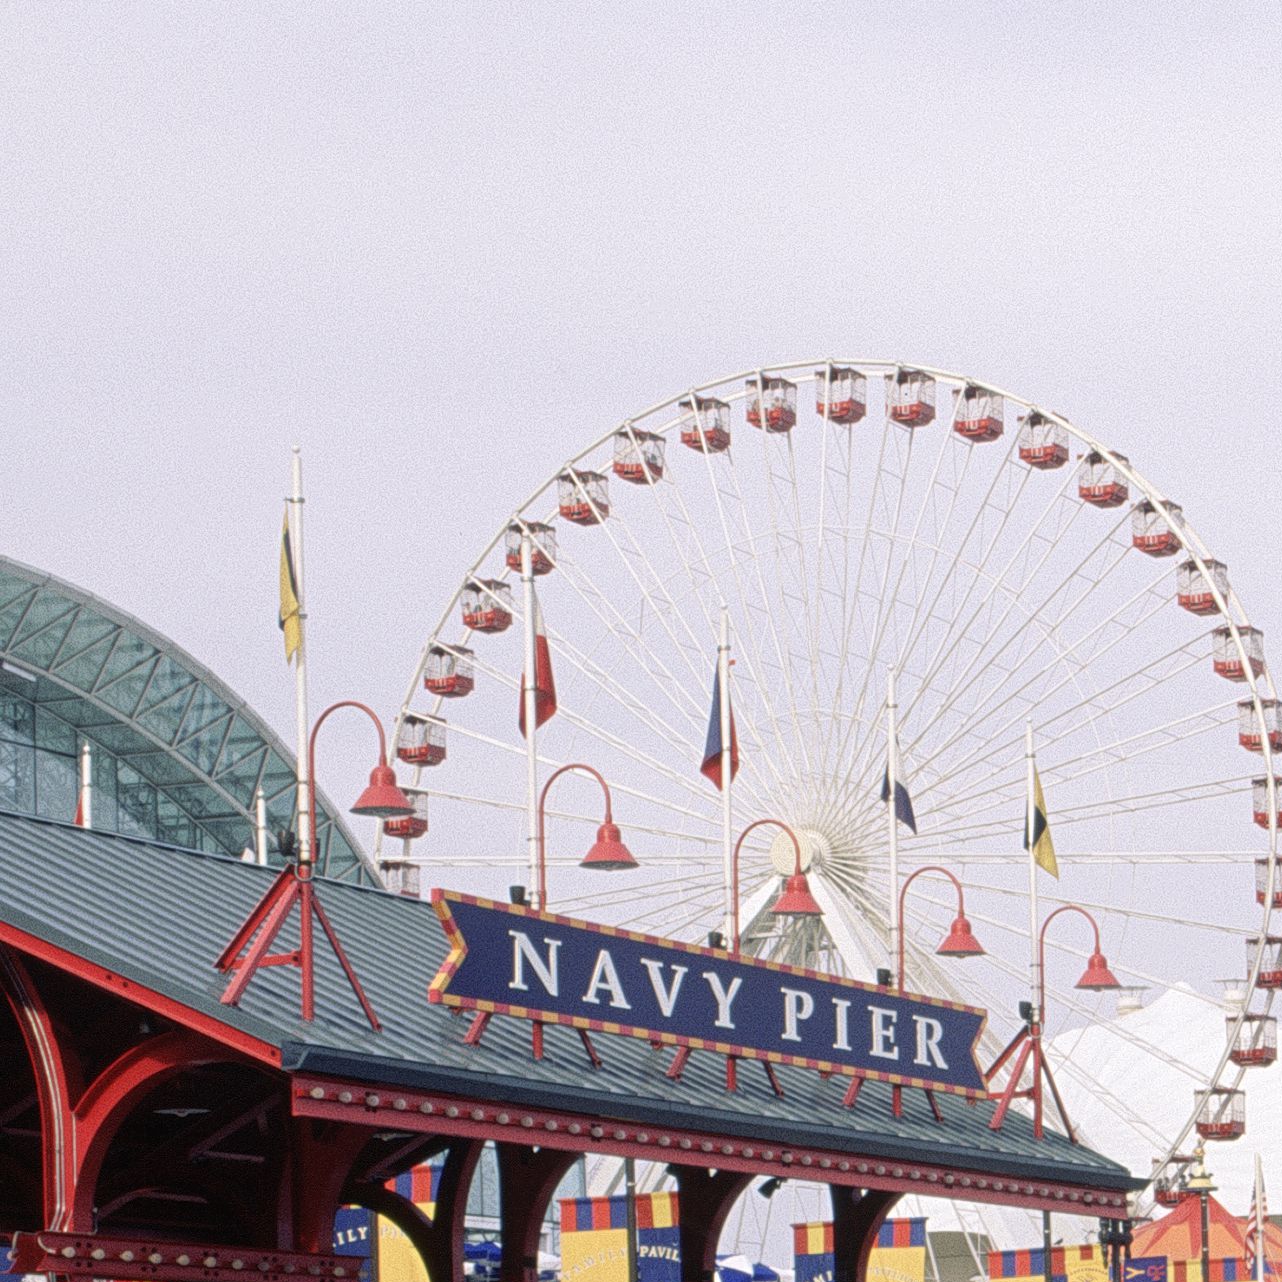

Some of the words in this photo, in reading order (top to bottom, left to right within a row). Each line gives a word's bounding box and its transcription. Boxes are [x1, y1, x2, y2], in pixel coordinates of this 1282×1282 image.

[509, 929, 742, 1029] NAVY
[781, 987, 949, 1070] PIER
[332, 1226, 368, 1247] ILY
[639, 1245, 681, 1263] PAVIL
